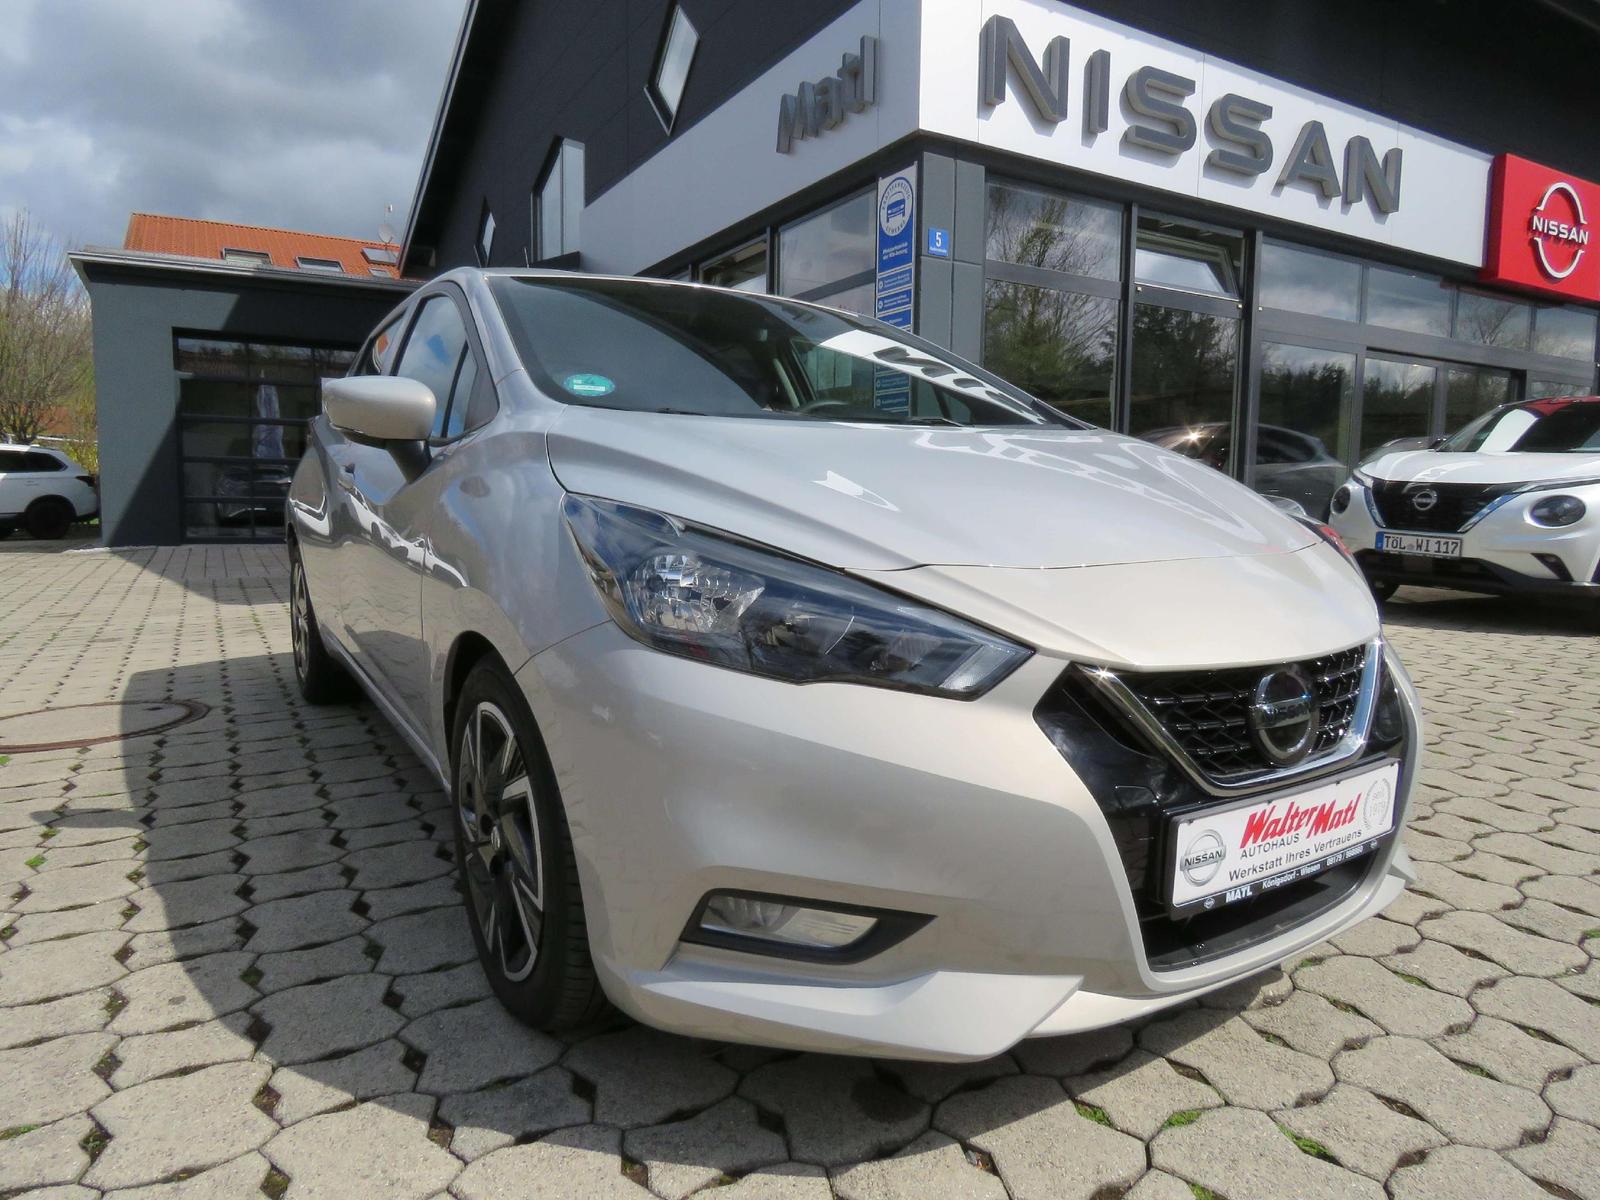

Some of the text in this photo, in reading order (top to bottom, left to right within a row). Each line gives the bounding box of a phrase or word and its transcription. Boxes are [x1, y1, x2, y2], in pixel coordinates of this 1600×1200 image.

[776, 35, 878, 154] Matl
[979, 14, 1403, 214] NISSAN
[935, 231, 942, 248] 5
[1532, 215, 1589, 245] NISSAN
[1434, 540, 1459, 555] 117
[1240, 802, 1318, 848] Walter
[1306, 792, 1362, 839] Matl
[1184, 850, 1223, 867] NISSAN
[1228, 856, 1283, 881] Werkstatt
[1285, 848, 1311, 864] Ihres
[1314, 829, 1362, 853] Vertrauens
[1240, 833, 1300, 860] AUTOHAUS
[1226, 886, 1253, 903] MATL
